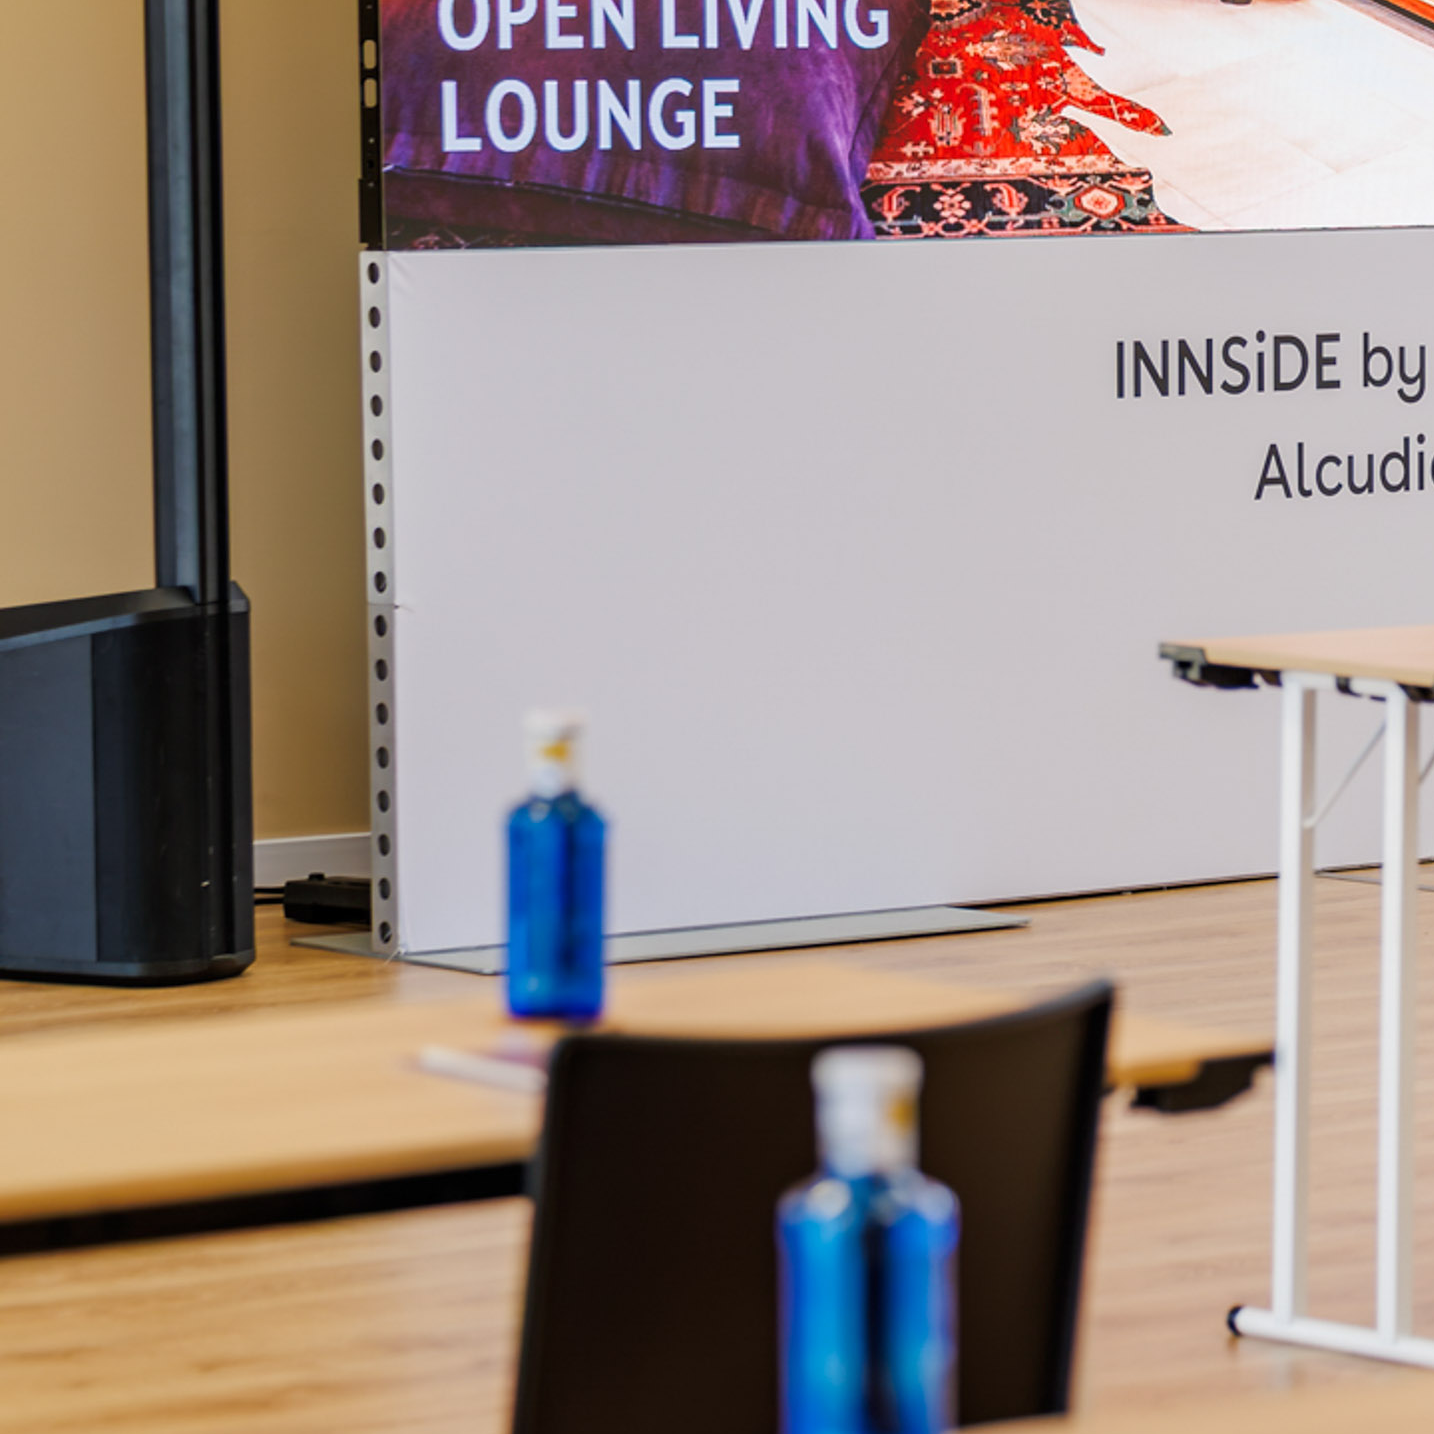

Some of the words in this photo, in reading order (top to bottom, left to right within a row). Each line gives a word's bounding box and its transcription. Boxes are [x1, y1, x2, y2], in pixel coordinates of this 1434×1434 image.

[441, 77, 741, 153] LOUNGE
[1116, 330, 1341, 399] INNSiDE
[1362, 332, 1427, 403] by
